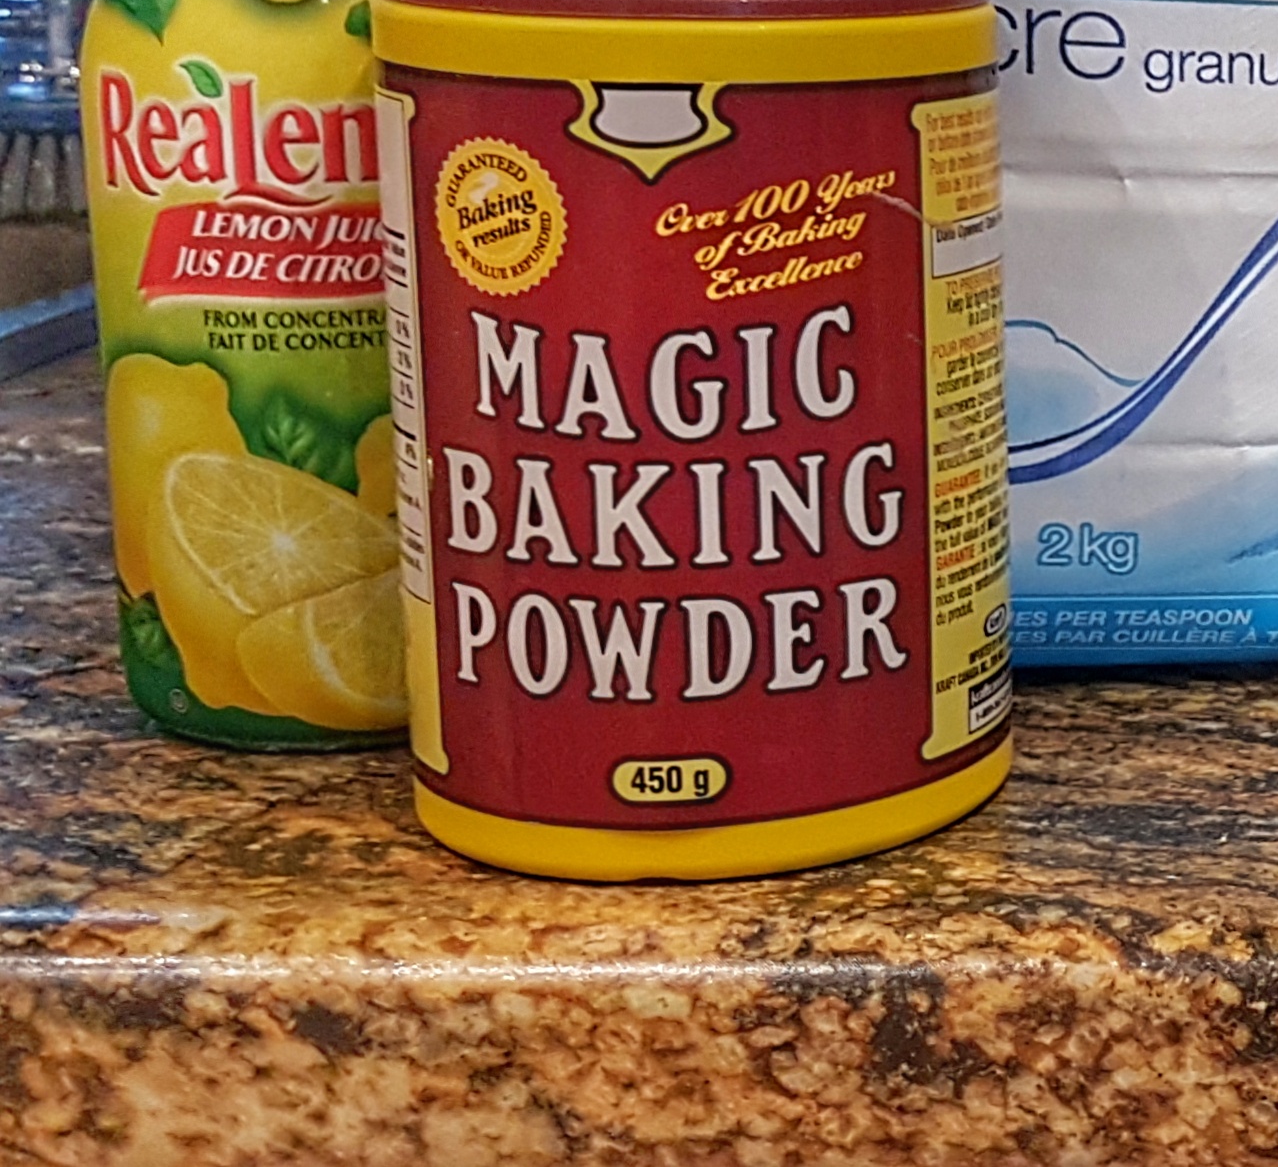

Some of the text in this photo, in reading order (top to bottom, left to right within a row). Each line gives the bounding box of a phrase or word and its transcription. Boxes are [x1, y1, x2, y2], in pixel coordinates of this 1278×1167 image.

[445, 152, 528, 208] GUARANTEED
[191, 209, 318, 243] LEMON
[456, 189, 538, 231] Baking
[655, 170, 897, 238] Over 100 Years
[470, 255, 509, 280] VALUE
[509, 210, 552, 279] REFUNDED
[471, 217, 531, 249] results
[693, 211, 867, 271] of Baking
[171, 244, 385, 283] JUS DE CITRO
[705, 251, 864, 302] Excellence
[203, 309, 258, 329] FROM
[208, 332, 247, 351] FAIT
[252, 333, 281, 352] DE
[471, 305, 856, 442] MAGIC
[441, 441, 905, 570] BAKING
[1036, 521, 1140, 576] 2 kg
[450, 577, 909, 702] POWDER
[1054, 608, 1253, 627] PER TEASPOON
[1054, 630, 1105, 644] PAR
[1111, 626, 1235, 644] CUILLÈRE
[630, 764, 711, 798] 450 g
